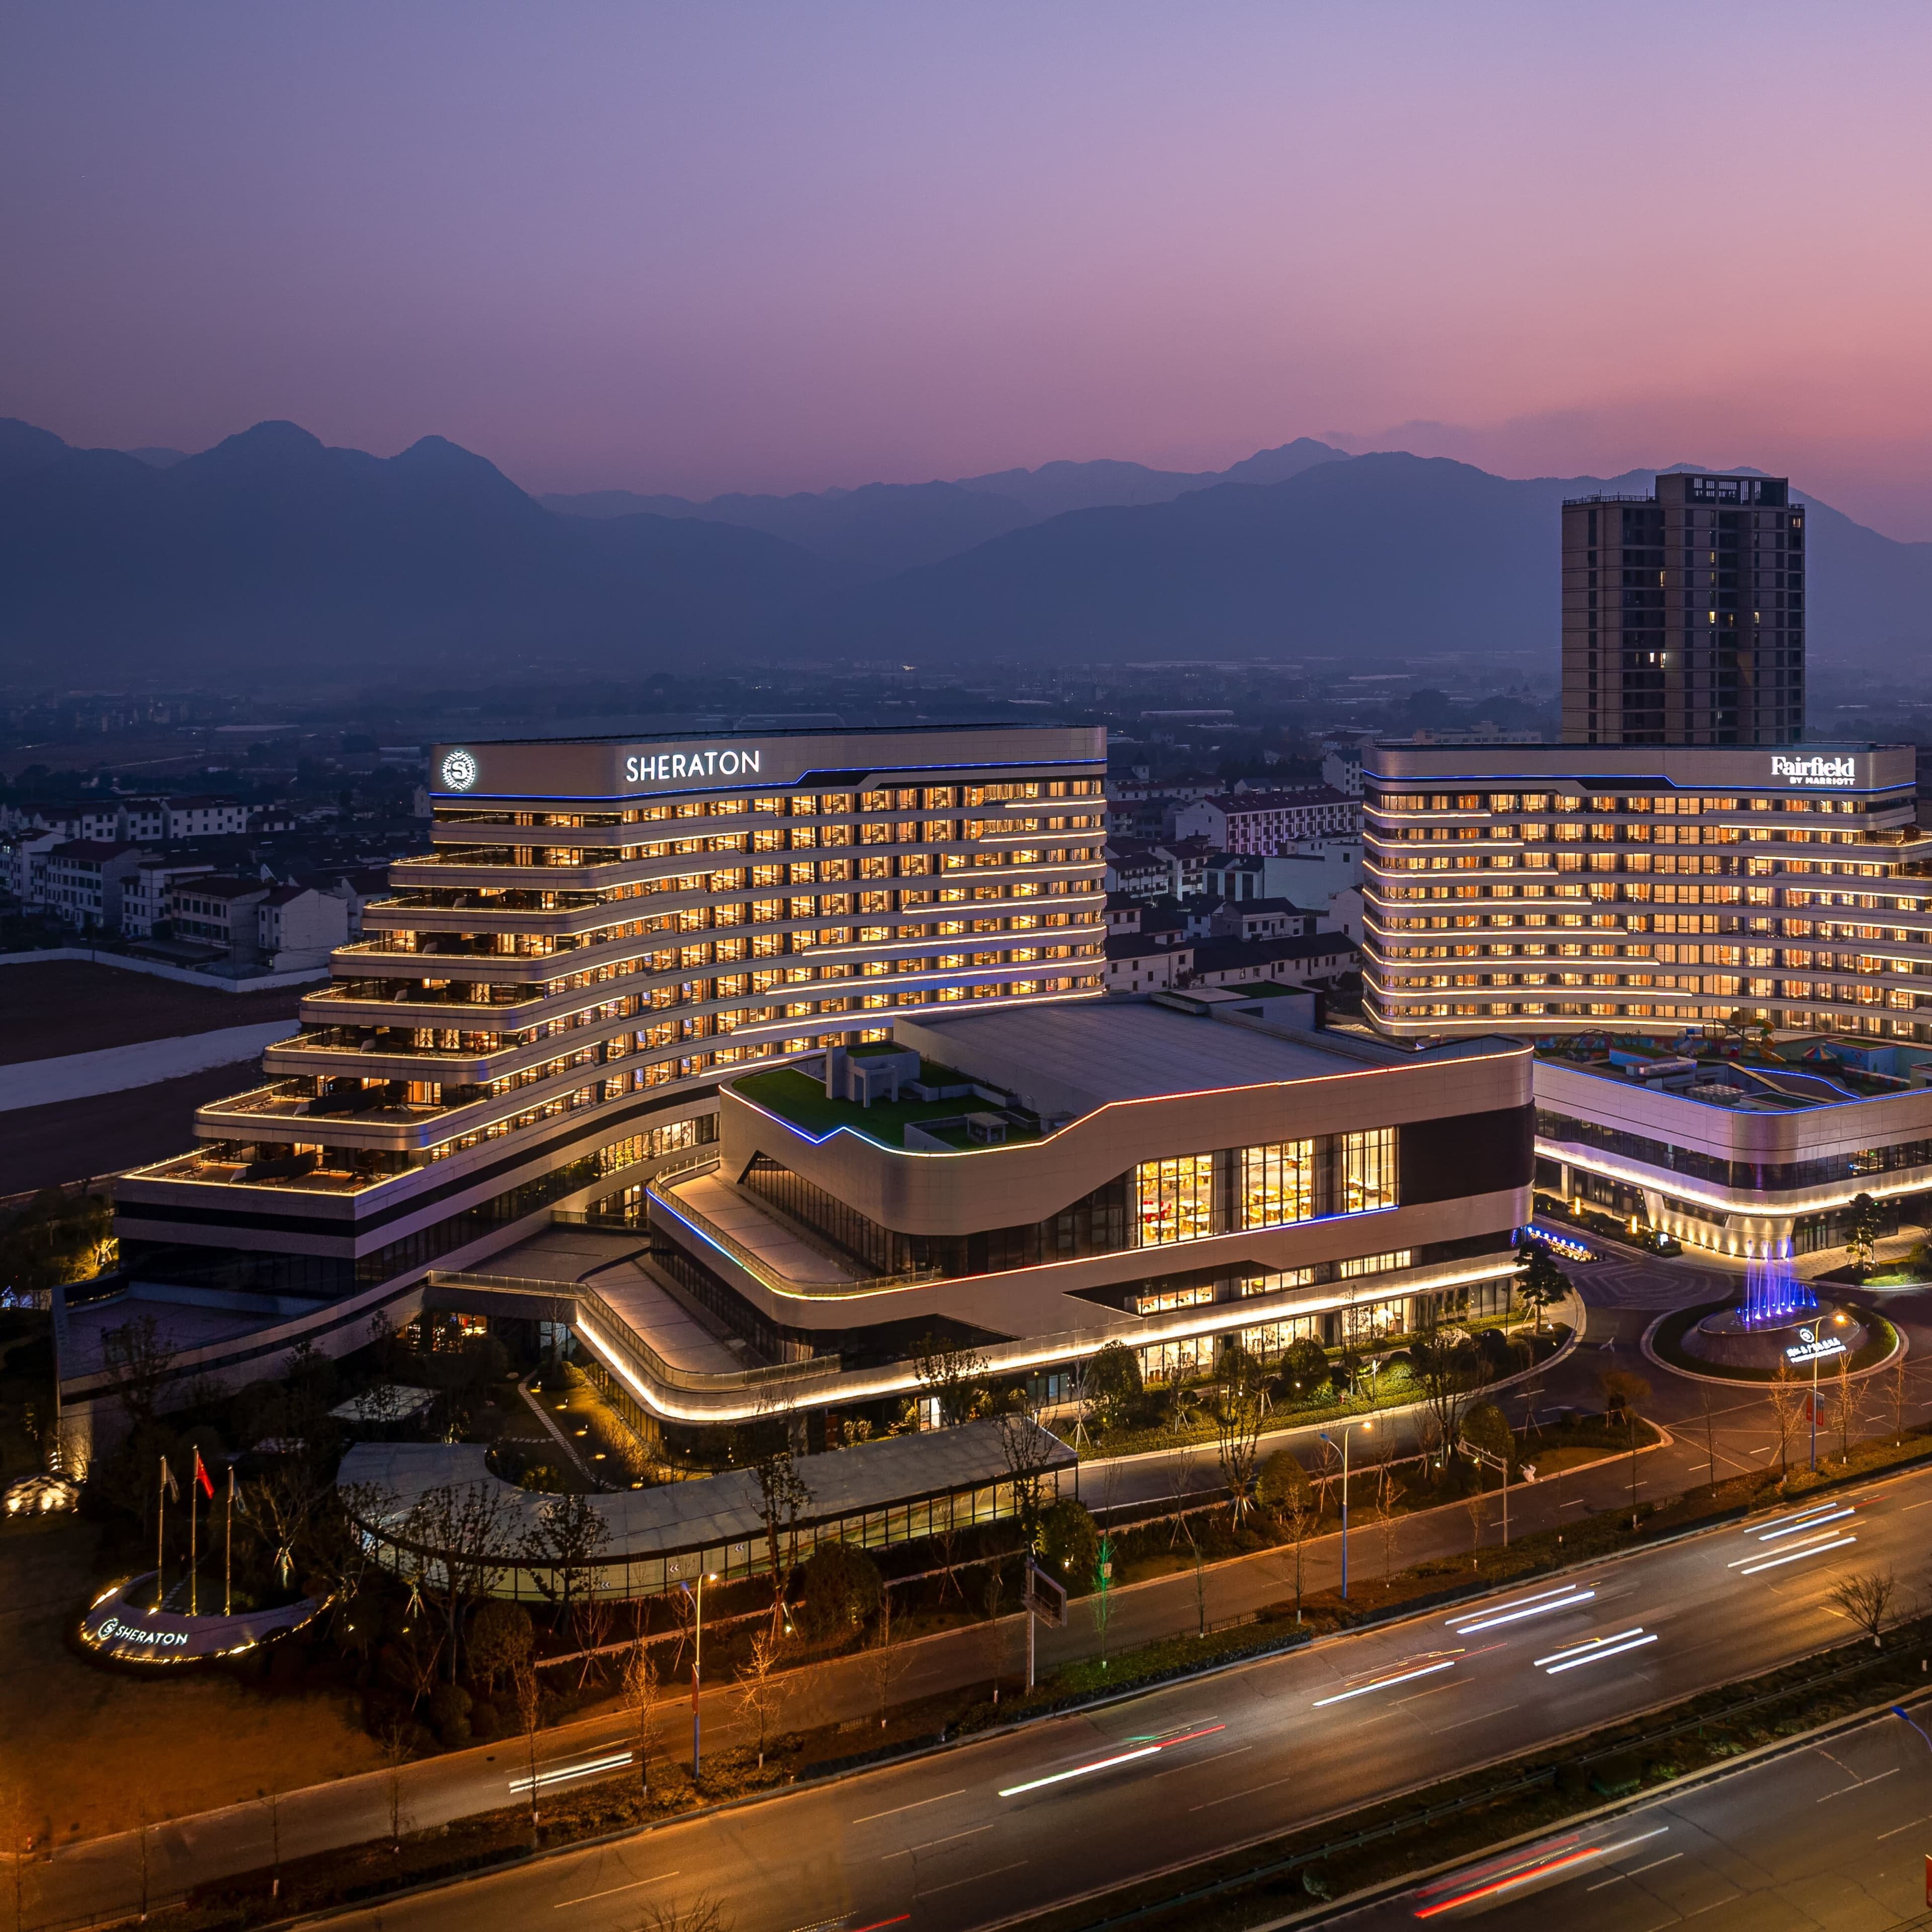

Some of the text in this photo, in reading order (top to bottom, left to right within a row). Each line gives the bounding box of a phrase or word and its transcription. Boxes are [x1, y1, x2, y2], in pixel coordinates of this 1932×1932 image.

[626, 750, 760, 782] SHERATON
[1770, 756, 1856, 777] Fairfield
[1789, 776, 1856, 786] BY MARRIOTT
[115, 1626, 188, 1645] SHERATON
